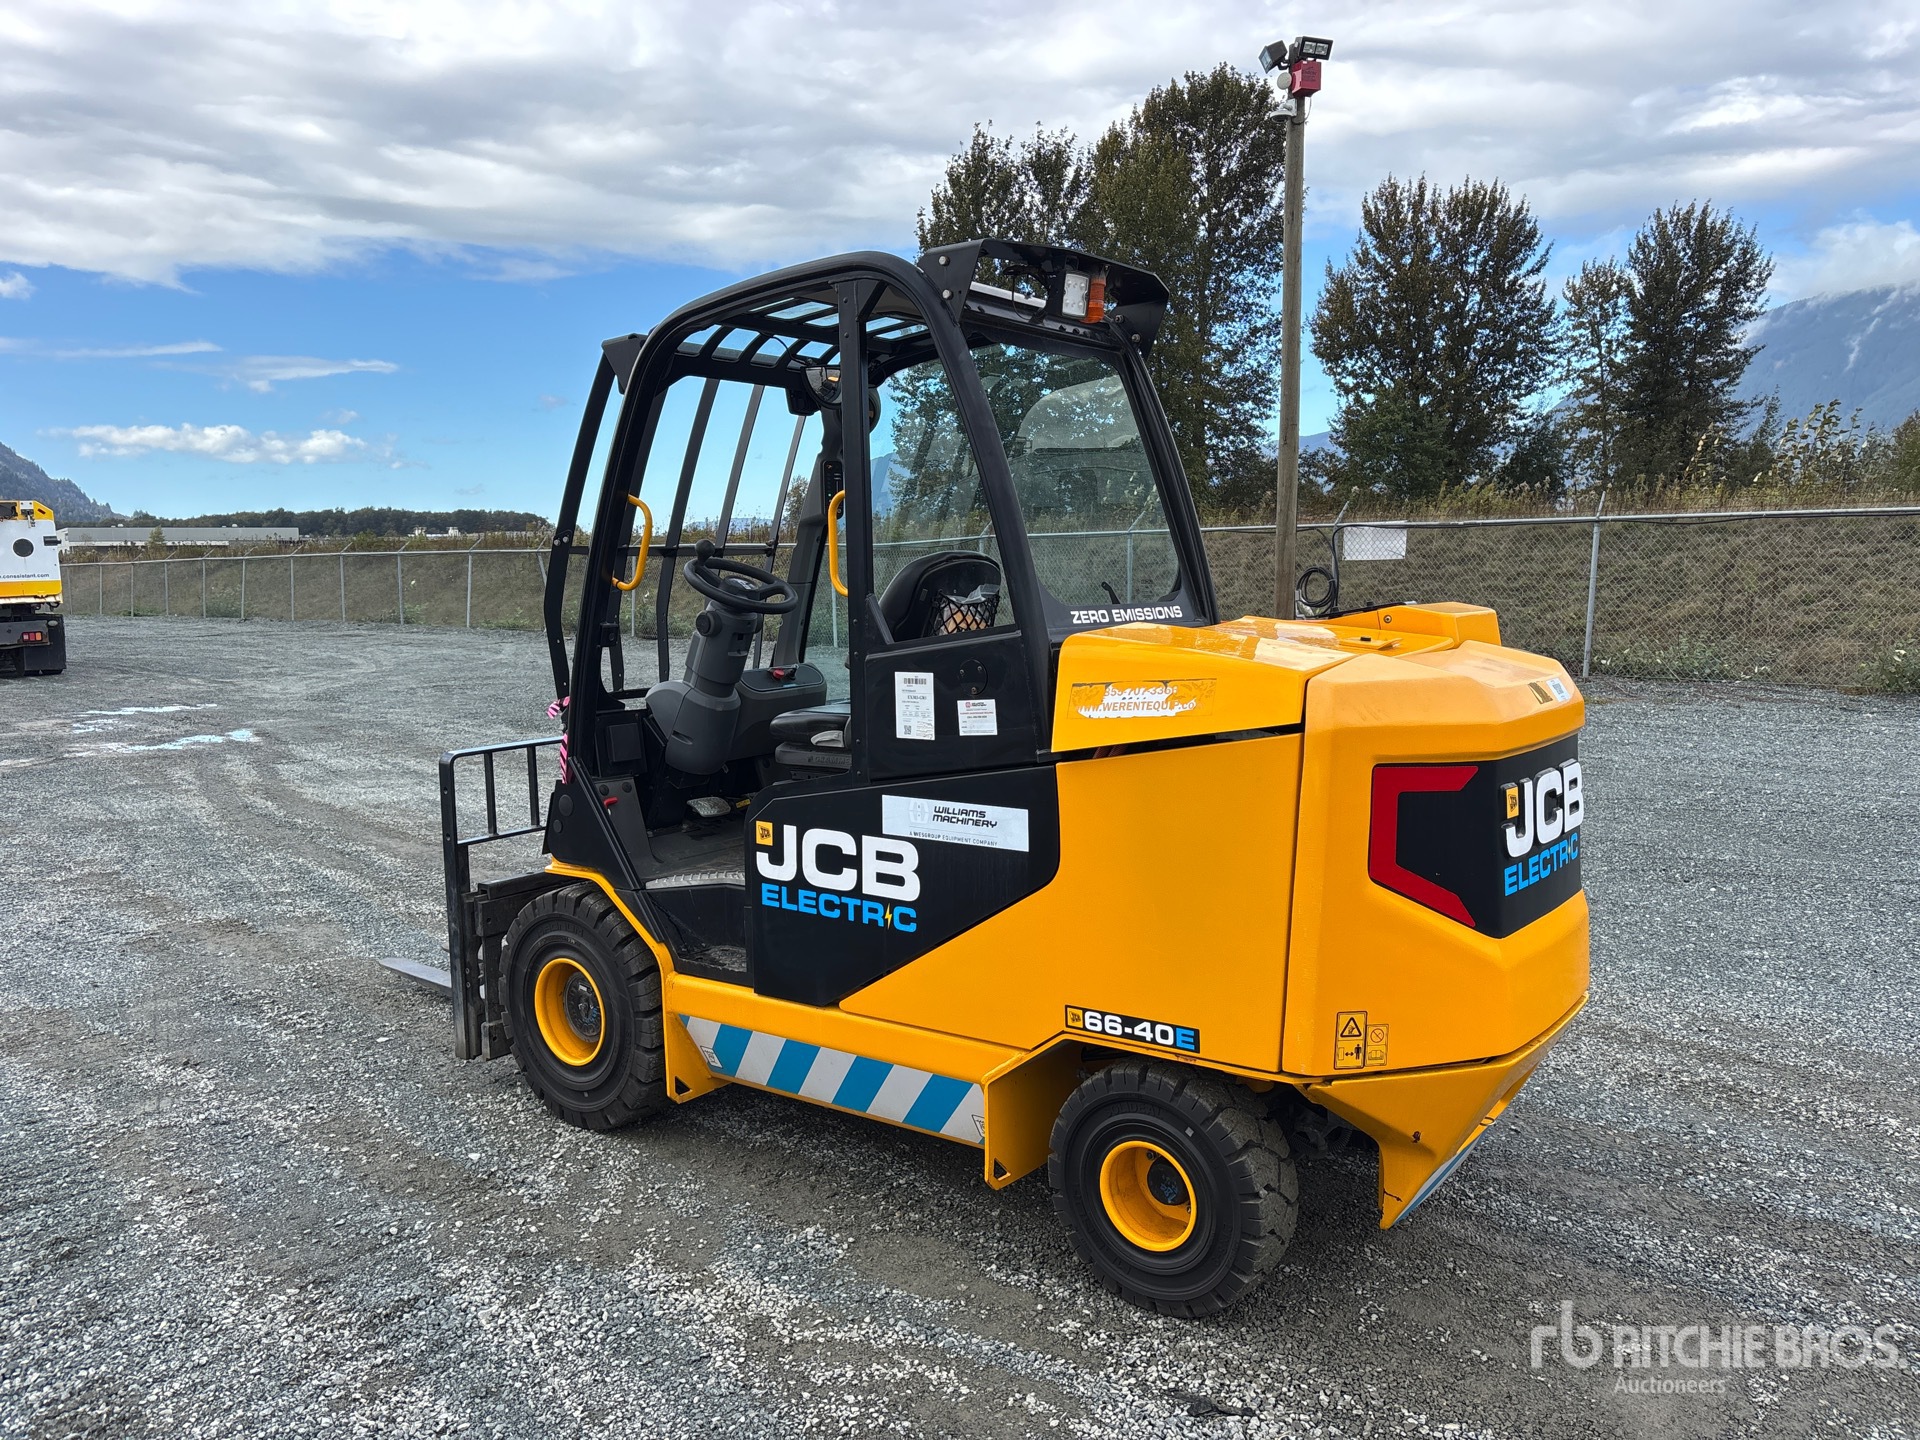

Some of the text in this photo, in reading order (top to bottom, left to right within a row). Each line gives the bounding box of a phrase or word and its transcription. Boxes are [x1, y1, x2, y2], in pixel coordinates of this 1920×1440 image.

[1070, 605, 1183, 625] ZERO EMISSIONS
[933, 806, 986, 819] WILLIAMS
[1505, 760, 1585, 858] JCB
[932, 814, 998, 828] MACHINERY
[942, 835, 971, 844] EQUIPMENT
[972, 838, 998, 847] COMPANY
[756, 824, 921, 901] JCB
[1084, 1010, 1196, 1050] 66-40E
